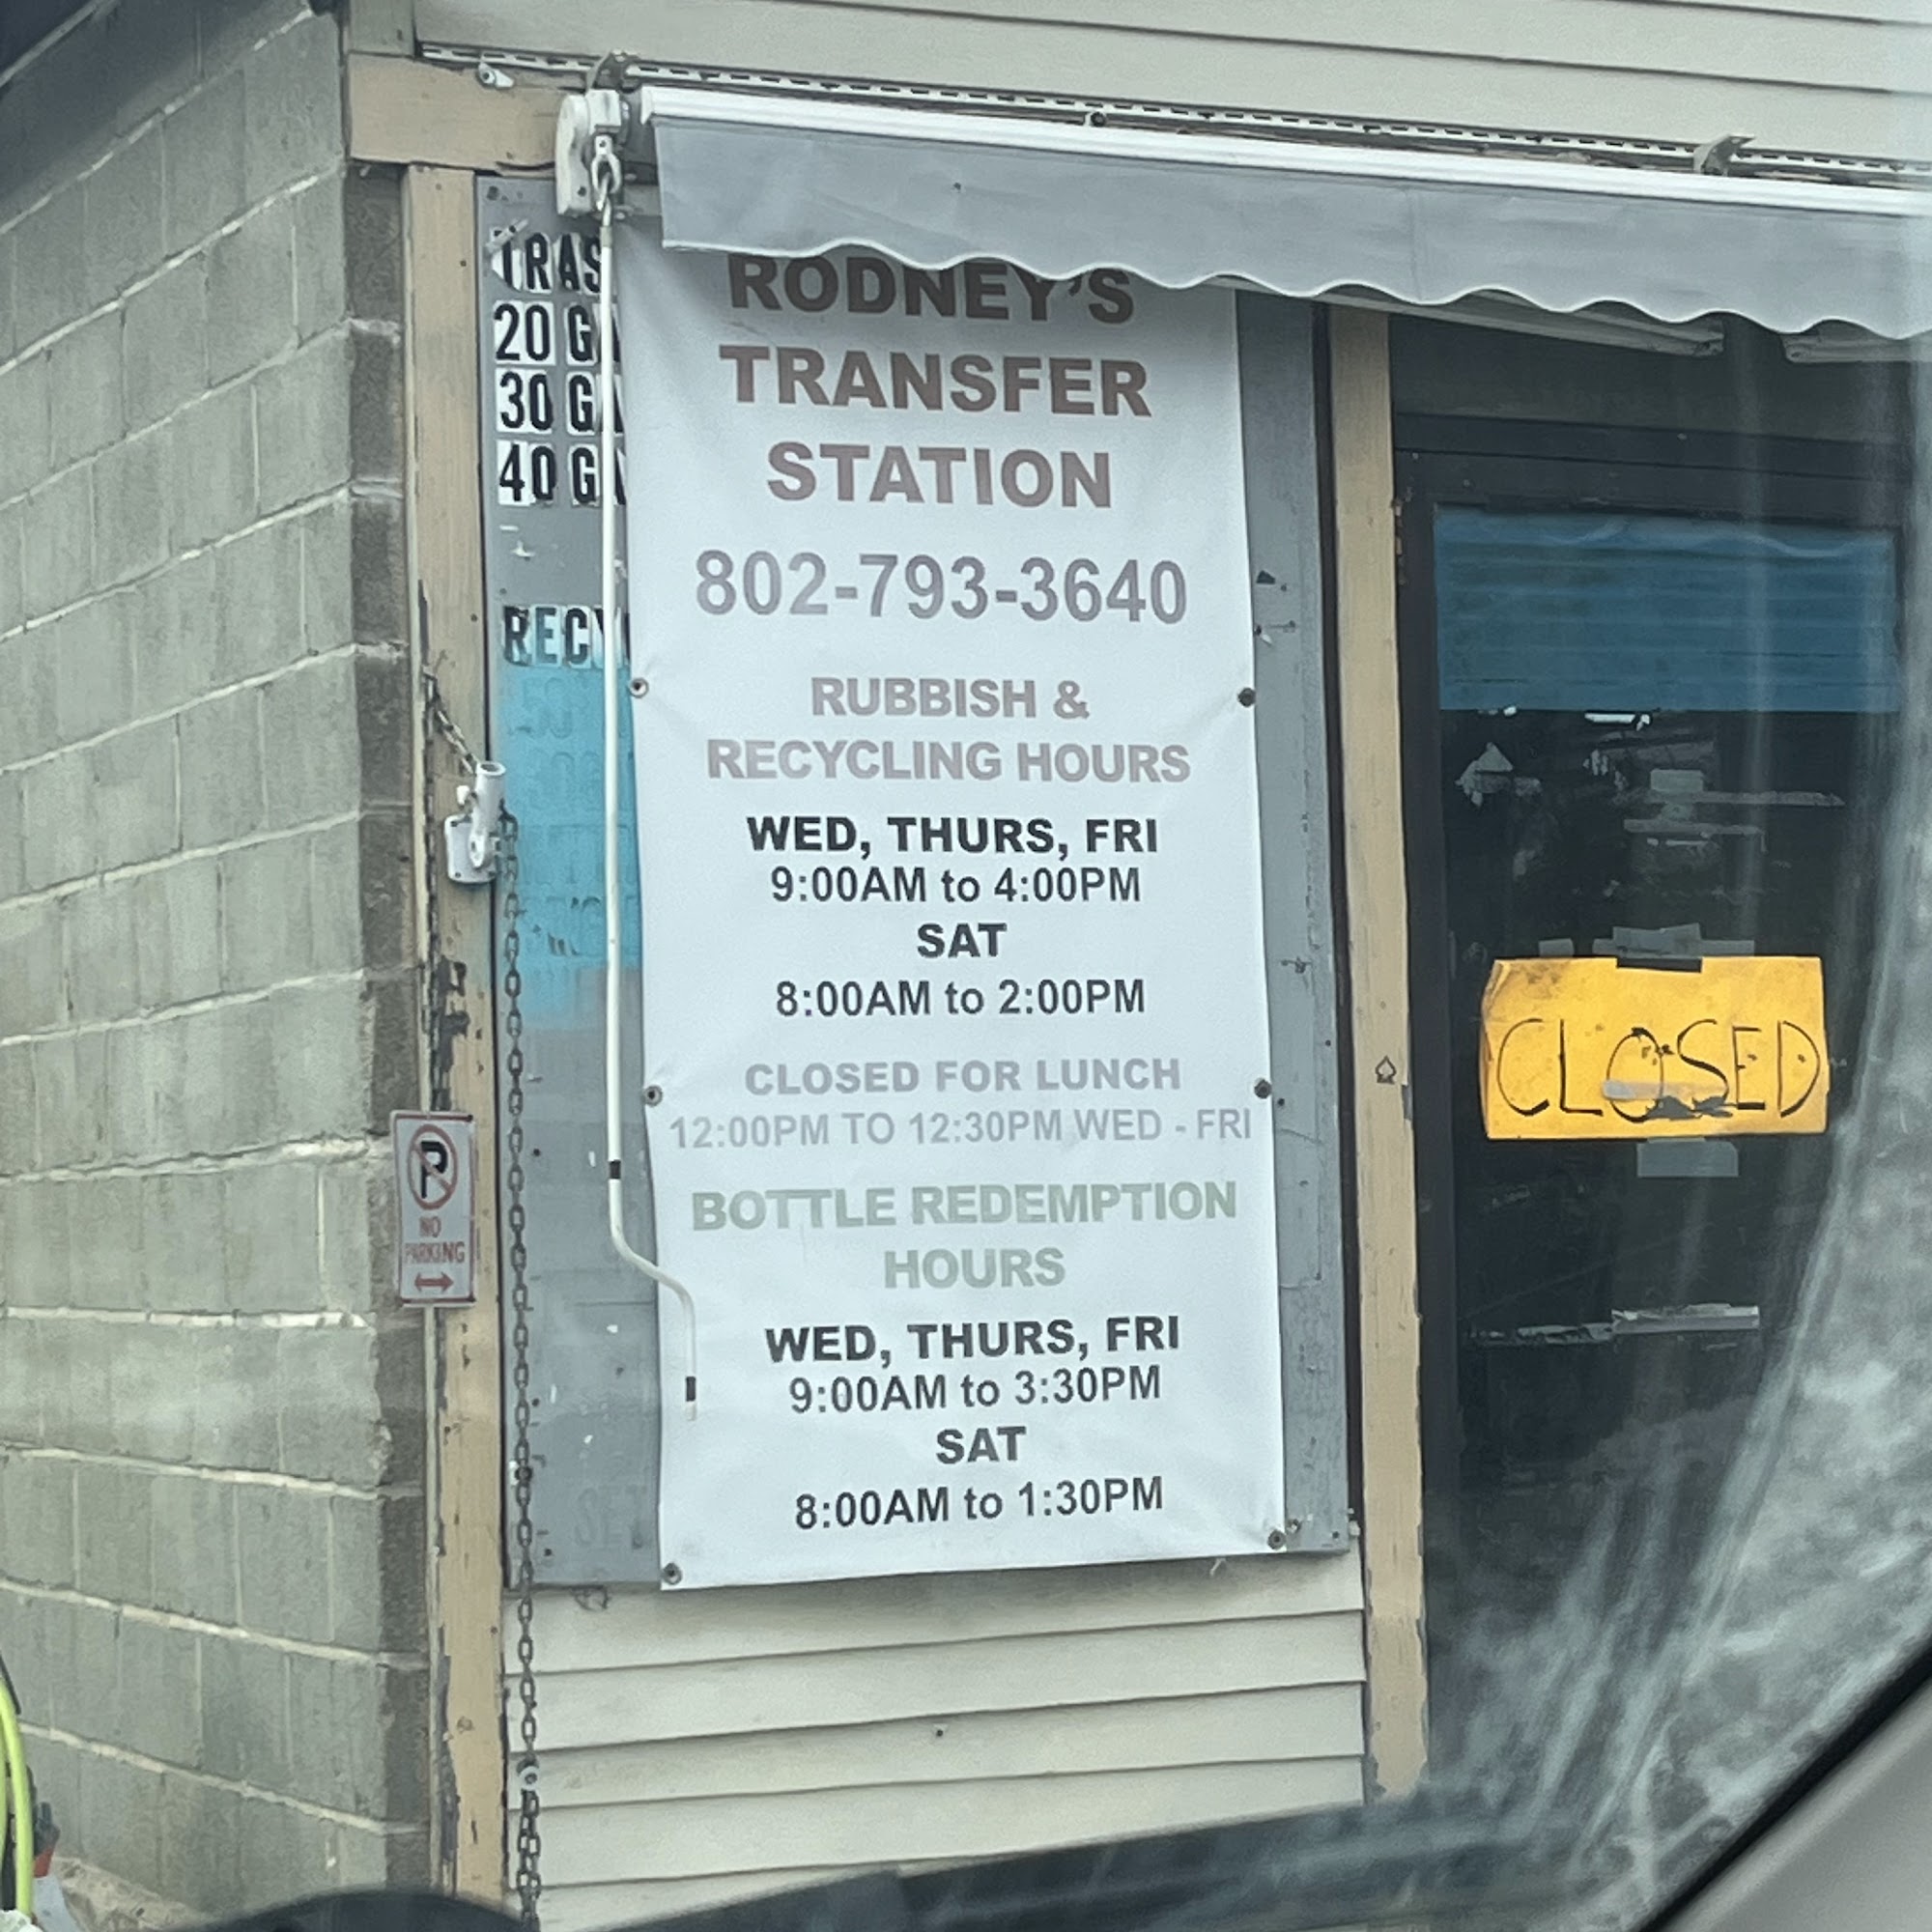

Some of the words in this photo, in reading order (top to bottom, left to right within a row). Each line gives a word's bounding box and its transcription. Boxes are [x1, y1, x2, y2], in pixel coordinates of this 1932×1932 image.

[727, 255, 1134, 325] RODNEY'S
[494, 303, 550, 361] 20
[499, 372, 554, 430] 30
[719, 345, 1151, 417] TRANSFER
[499, 444, 556, 501] 40
[767, 441, 1111, 508] STATION
[696, 550, 1186, 624] 802-793-3640
[811, 677, 1036, 718] RUBBISH
[1053, 680, 1090, 719] &
[708, 739, 1002, 781] RECYCLING
[1017, 743, 1190, 782] HOURS
[747, 816, 870, 860] WED,
[887, 817, 1067, 861] THURS,
[1087, 819, 1156, 852] FRI
[772, 867, 925, 902] 9:00AM
[941, 869, 980, 902] to
[994, 867, 1140, 902] 4:00PM
[918, 923, 1007, 958] SAT
[777, 980, 930, 1016] 8:00AM
[945, 981, 983, 1014] to
[999, 980, 1144, 1014] 2:00PM
[746, 1062, 919, 1095] CLOSED
[936, 1060, 1021, 1093] FOR
[1037, 1058, 1179, 1091] LUNCH
[1498, 1019, 1819, 1122] CLOSED
[669, 1114, 829, 1149] 12:00PM
[841, 1112, 895, 1145] TO
[909, 1109, 1062, 1144] 12:30PM
[1074, 1109, 1161, 1141] WED
[1198, 1108, 1250, 1139] FRI
[419, 1216, 441, 1237] NO
[692, 1187, 896, 1231] BOTTLE
[911, 1180, 1236, 1225] REDEMPTION
[405, 1241, 465, 1264] PARKING
[885, 1247, 1065, 1289] HOURS
[765, 1325, 891, 1369] WED,
[907, 1320, 1088, 1361] THURS,
[1107, 1316, 1178, 1351] FRI
[790, 1375, 946, 1413] 9:00AM
[960, 1375, 1000, 1407] to
[1015, 1365, 1159, 1405] 3:30PM
[936, 1426, 1026, 1464] SAT
[796, 1487, 949, 1529] 8:00AM
[964, 1488, 1003, 1520] to
[1019, 1476, 1162, 1516] 1:30PM
